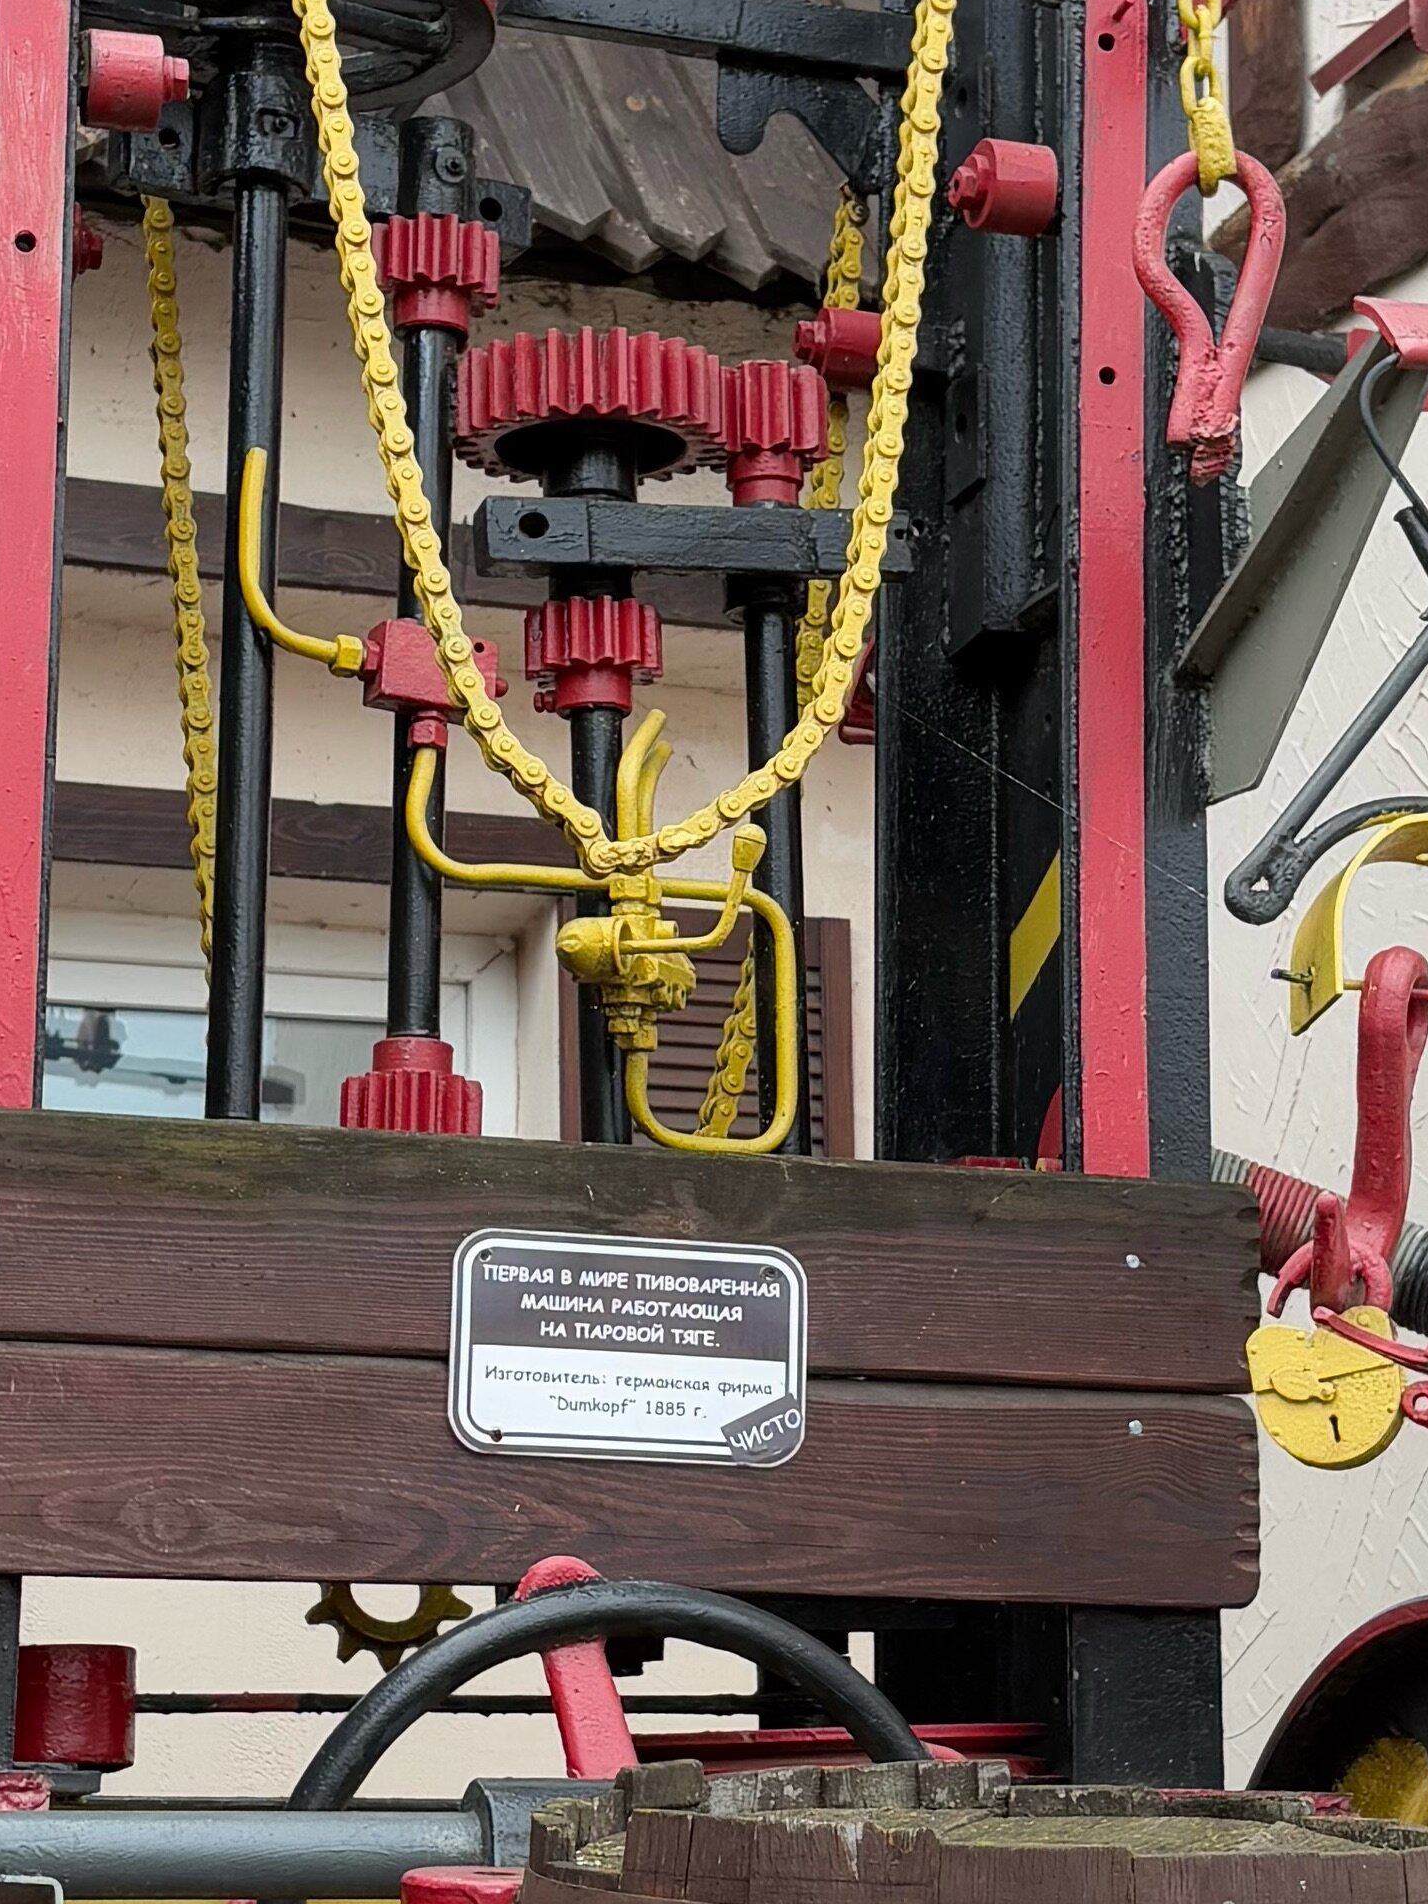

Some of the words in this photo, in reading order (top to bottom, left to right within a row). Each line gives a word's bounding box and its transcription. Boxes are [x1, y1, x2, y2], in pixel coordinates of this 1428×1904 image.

[483, 1263, 554, 1284] ПЕРВАЯ
[561, 1269, 572, 1285] В
[579, 1270, 629, 1289] МИРЕ
[636, 1273, 780, 1298] ПИВОВАРЕННАЯ
[521, 1293, 605, 1314] МАШИНА
[611, 1298, 743, 1322] РАБОТАЮЩАЯ
[540, 1320, 567, 1338] НА
[574, 1322, 664, 1343] ПАРОВОЙ
[671, 1329, 720, 1347] ТЯГЕ.
[485, 1365, 606, 1384] Изготовитель:
[616, 1375, 710, 1391] германская
[717, 1381, 772, 1397] фирма
[646, 1400, 686, 1416] 1885
[694, 1406, 707, 1418] г.
[730, 1408, 801, 1451] ЧИСТО
